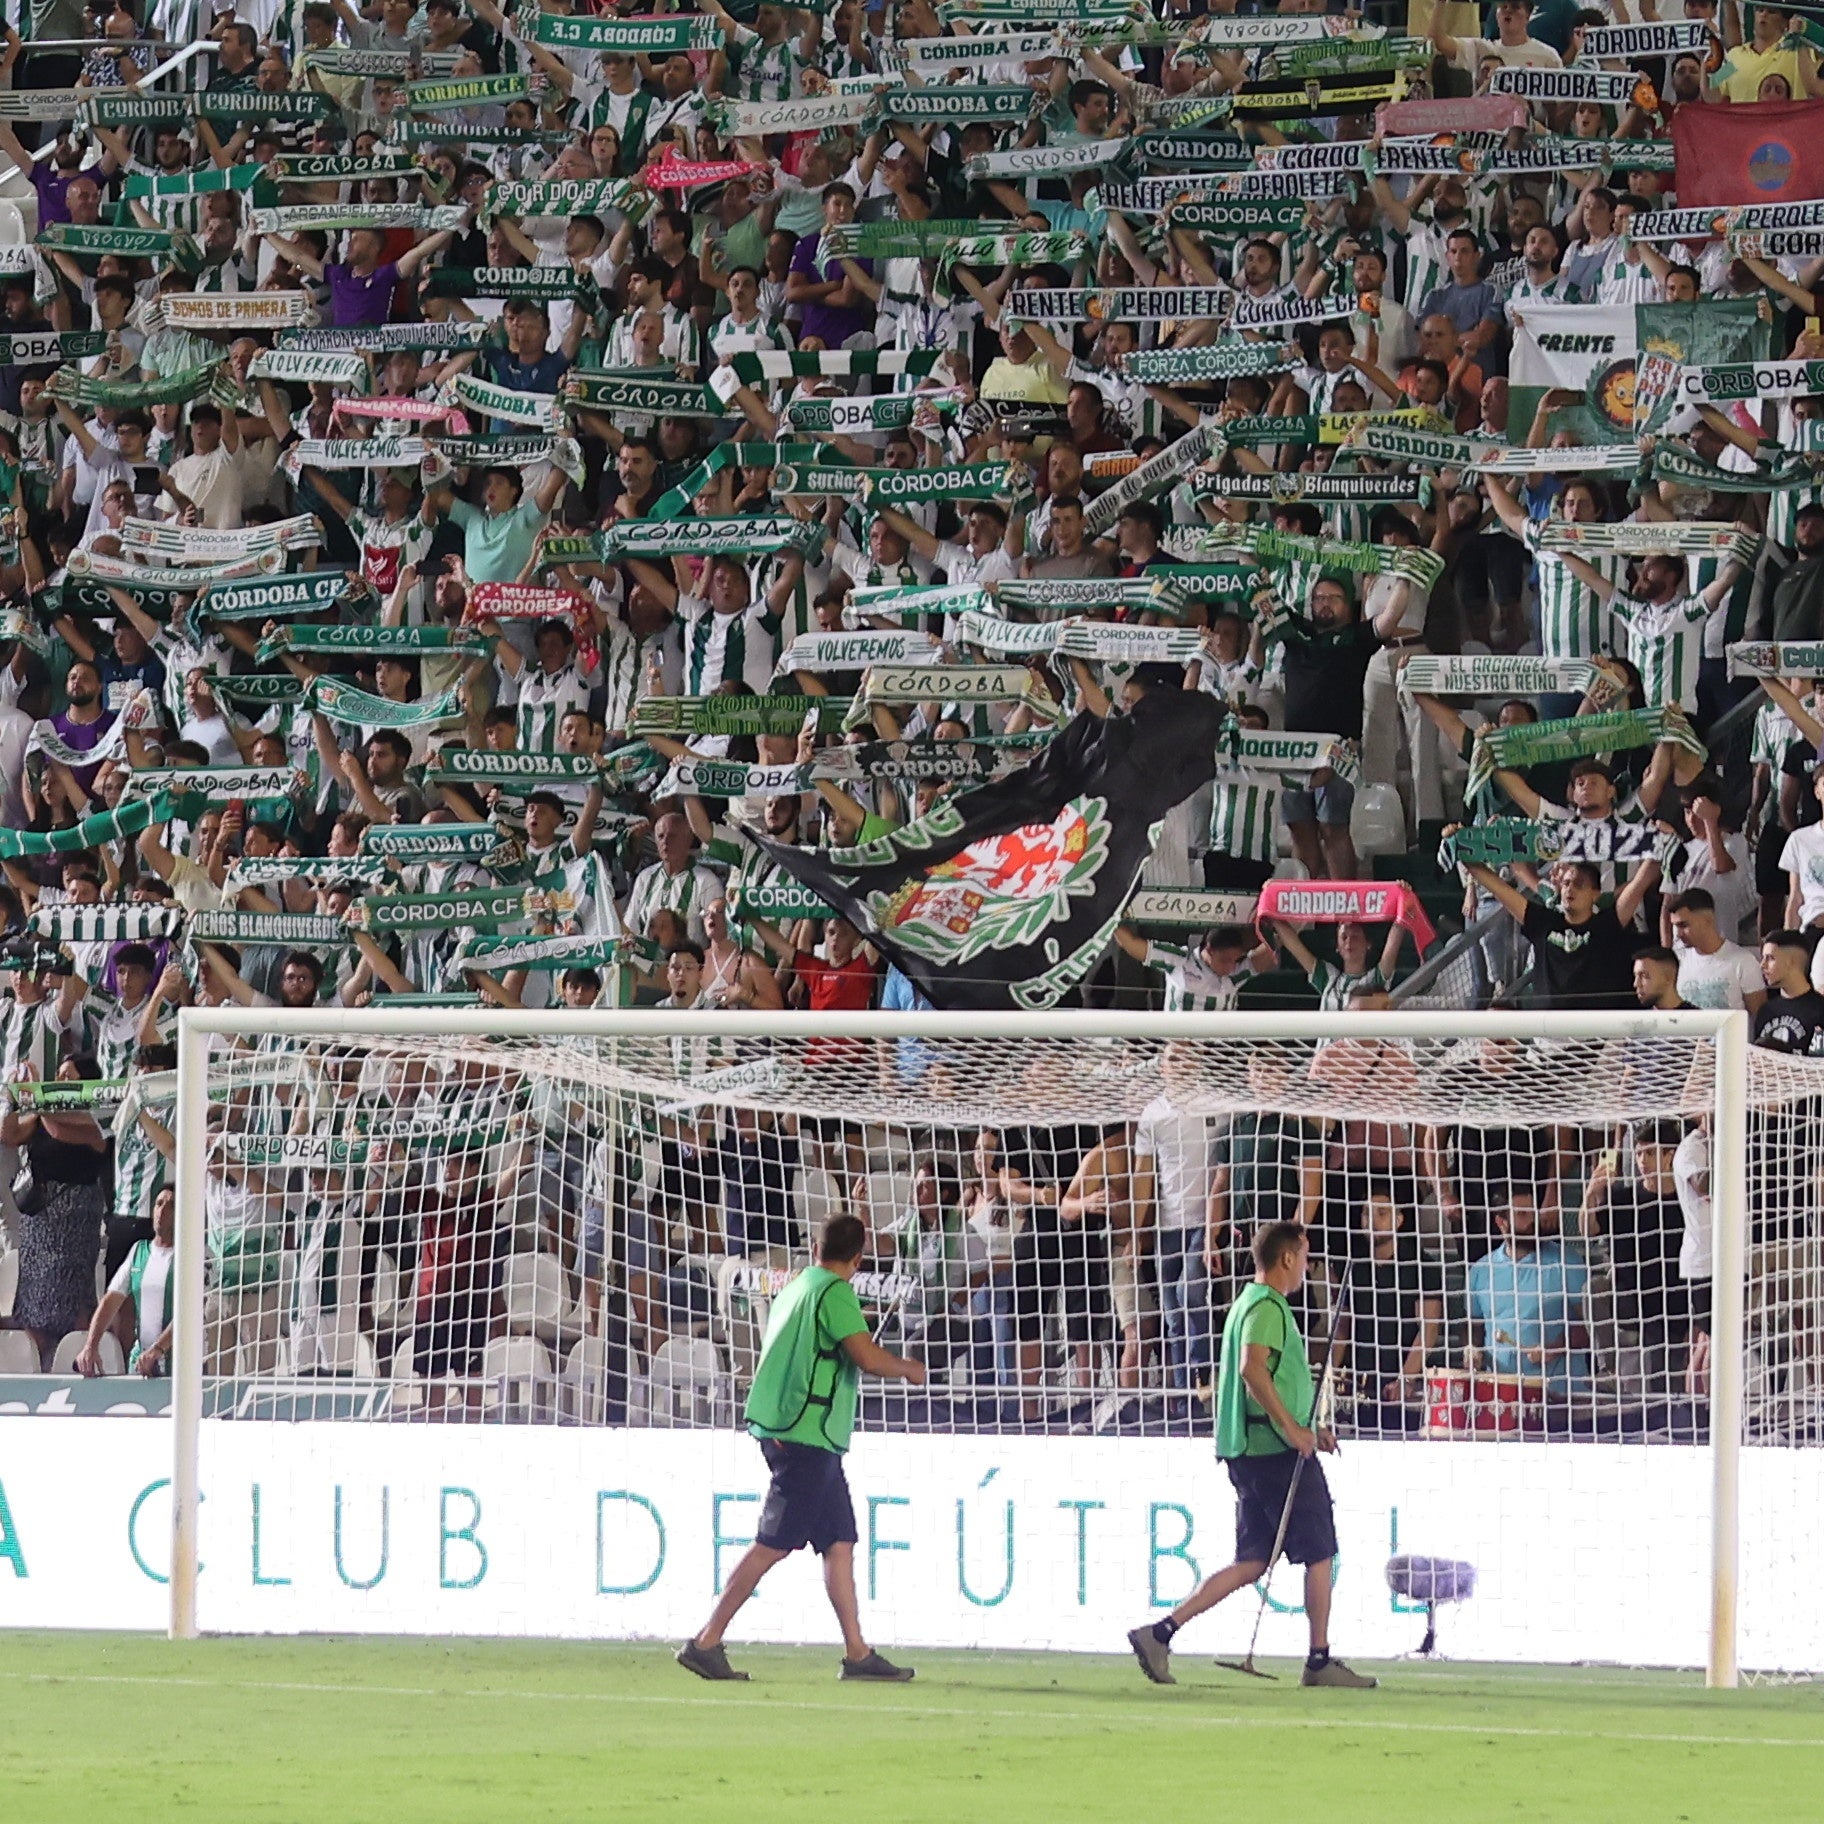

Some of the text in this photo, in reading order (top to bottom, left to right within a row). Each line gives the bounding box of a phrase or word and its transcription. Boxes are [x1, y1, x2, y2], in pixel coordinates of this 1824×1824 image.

[295, 95, 318, 113] CF
[1144, 138, 1251, 161] CÓRDOBA
[1378, 146, 1454, 172] FRENTE
[296, 156, 396, 175] CÓRDOBA
[1633, 210, 1710, 236] FRENTE
[172, 299, 288, 318] SOMOS DE PRIMERA
[1118, 289, 1230, 318] PEROLETE
[1538, 332, 1615, 354] FRENTE
[1139, 350, 1269, 372] FORZA CÓRDOBA
[1684, 366, 1811, 393] CÓRDOBA
[324, 436, 401, 460] VOLVEREMOS
[880, 466, 1005, 495] CÓRDOBA CF
[1195, 473, 1415, 496] Brigadas Blanquiverdes
[210, 577, 343, 614] CÓRDOBA CF
[210, 585, 309, 611] CÓRDOBA
[817, 635, 905, 661] VOLVEREMOS
[1448, 657, 1466, 674] EL
[881, 670, 1007, 694] CÓRDOBA
[1445, 672, 1557, 692] NUESTRO REINO
[377, 895, 519, 923] CÓRDOBA CF
[127, 1474, 489, 1592] CLUB
[594, 1489, 762, 1598] DE
[865, 1466, 1433, 1616] FÚTBL
